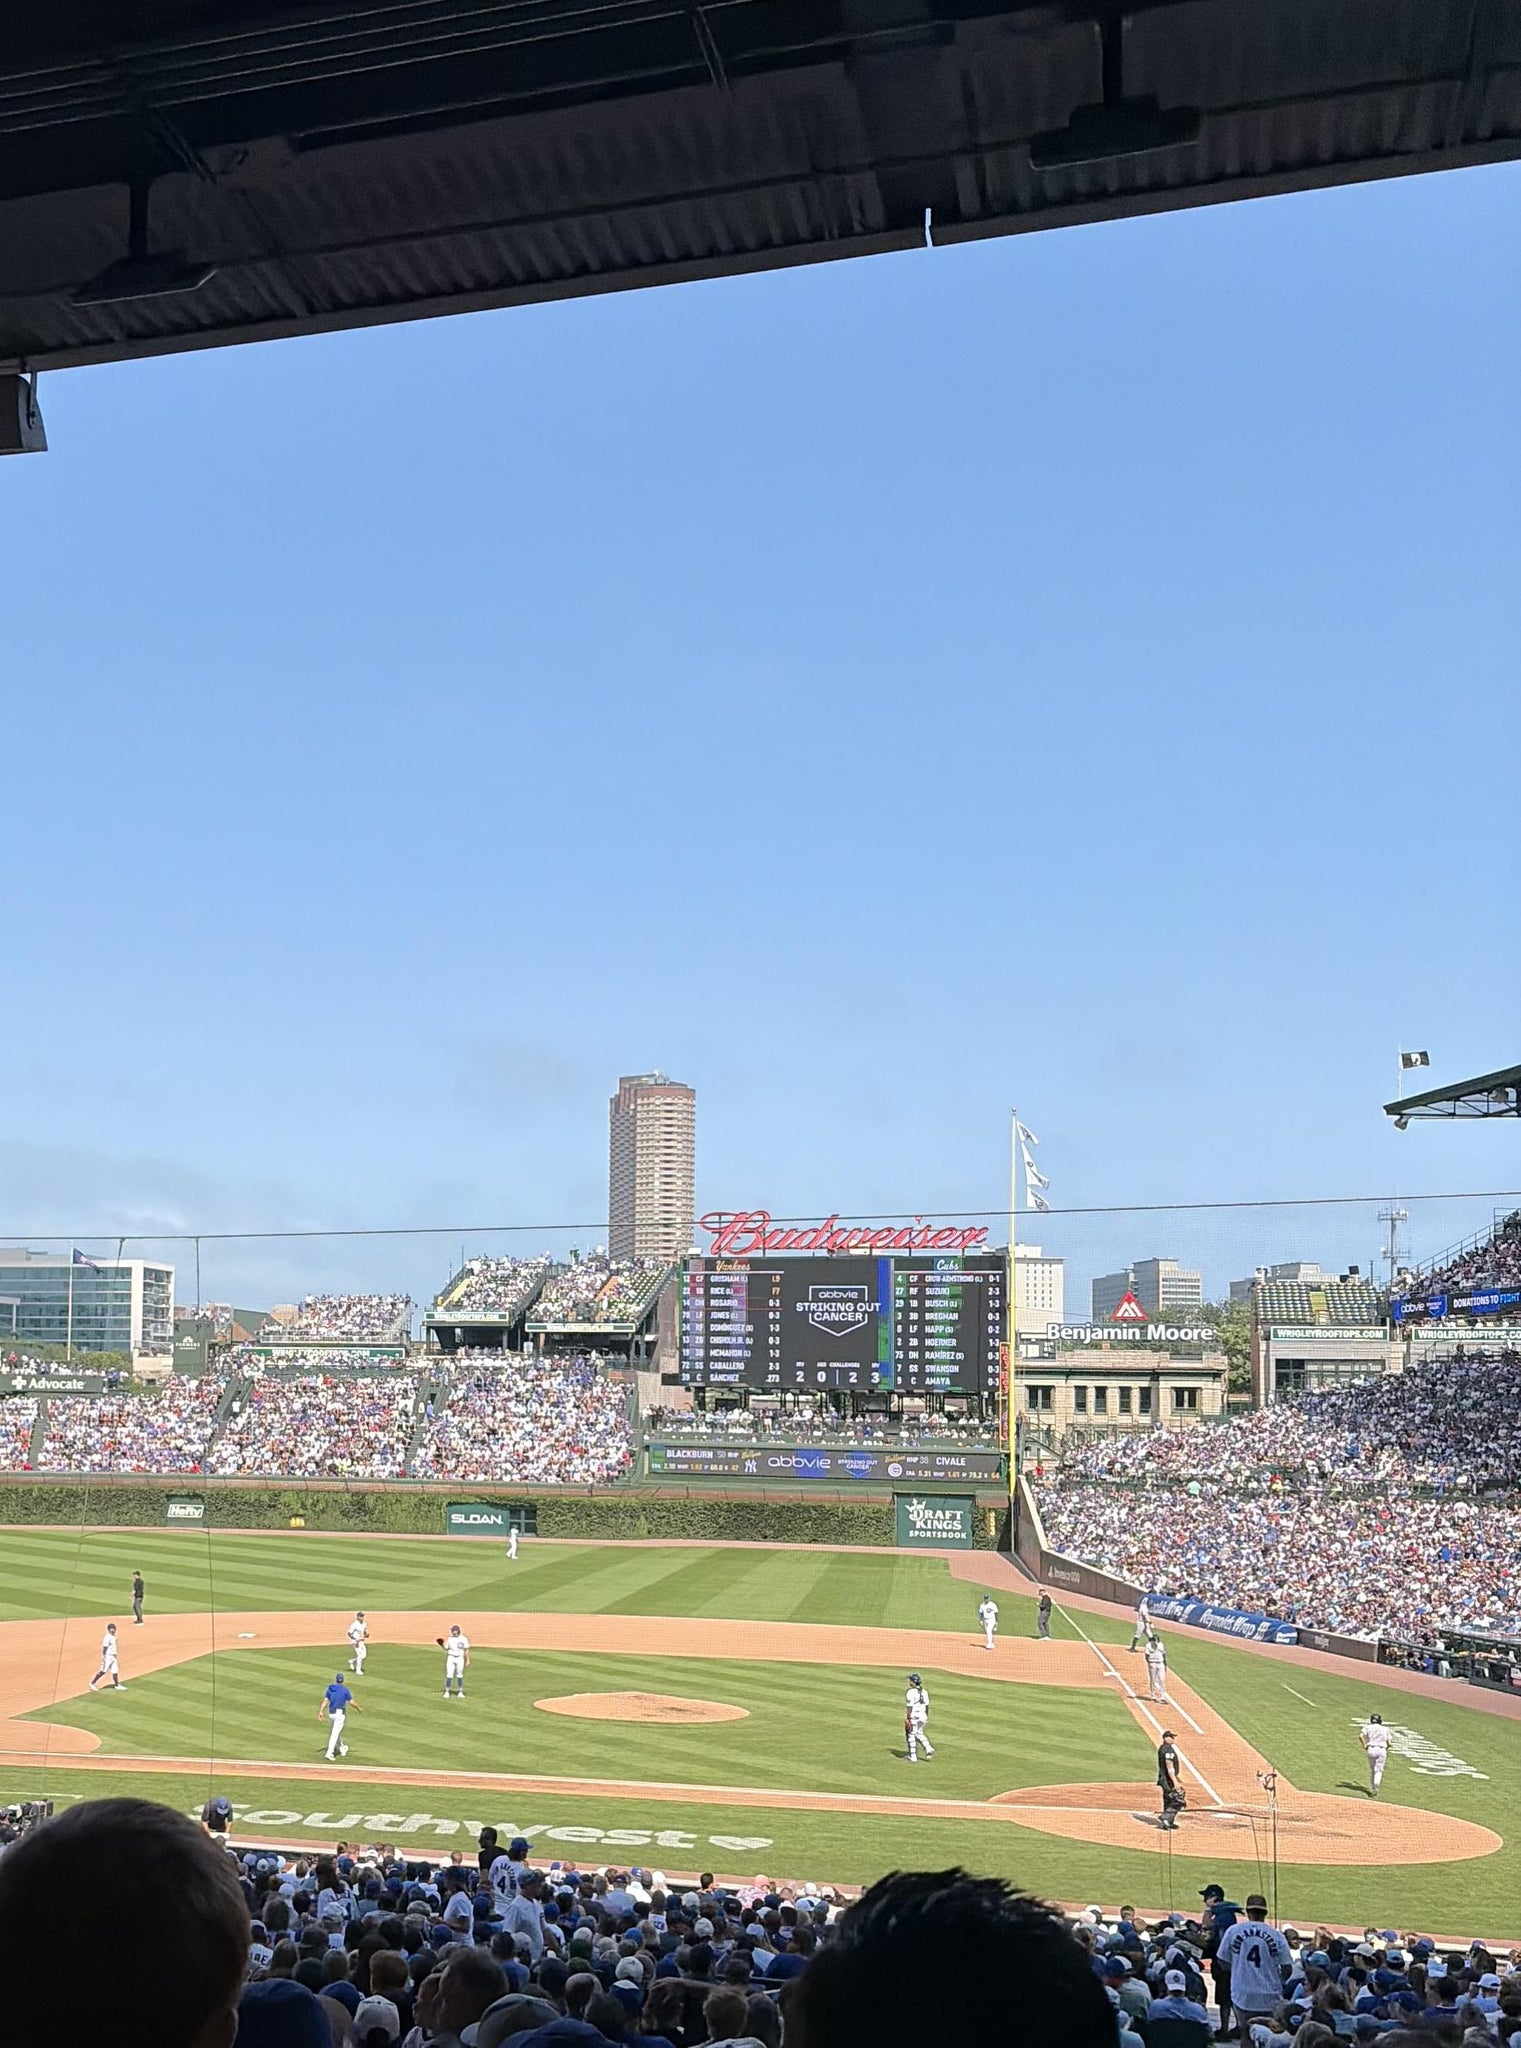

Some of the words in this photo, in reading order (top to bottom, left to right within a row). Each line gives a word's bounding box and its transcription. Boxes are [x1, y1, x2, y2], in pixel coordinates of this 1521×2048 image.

[700, 1210, 989, 1255] Budweiser
[716, 1260, 751, 1272] Yankees
[937, 1259, 959, 1271] Cubs
[897, 1275, 902, 1283] 4
[909, 1275, 918, 1283] CF
[988, 1275, 1000, 1283] 0-1
[710, 1287, 725, 1295] RICE
[818, 1290, 858, 1299] abbvie
[895, 1287, 904, 1295] 27
[925, 1287, 950, 1295] SUZUKI
[987, 1287, 1000, 1295] 2-3
[710, 1299, 738, 1307] ROSARIO
[769, 1299, 780, 1307] 0-3
[925, 1299, 949, 1307] BUSCH
[988, 1299, 1000, 1307] 1-3
[1453, 1296, 1490, 1309] DONATIONS
[1491, 1294, 1499, 1305] TO
[1500, 1292, 1520, 1304] FIGHT
[796, 1302, 854, 1312] STRIKING
[856, 1303, 881, 1312] OUT
[1401, 1302, 1425, 1313] abbvie
[710, 1311, 730, 1319] JONES
[769, 1311, 780, 1319] 0-3
[813, 1312, 863, 1321] CANCER
[897, 1312, 902, 1320] 3
[987, 1312, 1000, 1320] 0-3
[769, 1323, 780, 1332] 1-3
[909, 1325, 918, 1333] LF
[925, 1325, 945, 1333] HAPP
[987, 1325, 1000, 1333] 0-2
[1047, 1323, 1141, 1344] Benjamin
[1147, 1324, 1214, 1341] Moore
[768, 1336, 780, 1344] 0-3
[897, 1338, 902, 1347] 2
[988, 1338, 1000, 1347] 1-3
[769, 1349, 780, 1357] 1-3
[895, 1351, 904, 1359] 75
[909, 1351, 919, 1359] DH
[987, 1351, 1000, 1359] 0-3
[897, 1364, 902, 1373] 7
[909, 1364, 919, 1373] SS
[987, 1364, 1000, 1373] 0-3
[795, 1371, 805, 1382] 2
[817, 1371, 826, 1382] 0
[849, 1372, 858, 1383] 2
[871, 1372, 880, 1383] 3
[911, 1376, 917, 1386] C
[925, 1376, 951, 1386] AMAYA
[987, 1376, 1000, 1386] 0-3
[28, 1377, 85, 1390] Advocate
[666, 1450, 713, 1459] BLACKBURN
[768, 1455, 831, 1469] abbvie
[936, 1457, 966, 1466] CIVALE
[451, 1513, 503, 1525] SLOAN
[909, 1509, 964, 1521] DRAFT
[915, 1518, 963, 1531] KINGS
[908, 1530, 968, 1540] SPORTSBOOK
[1199, 1608, 1233, 1631] Reynolds
[1231, 1616, 1257, 1639] Wrap
[496, 1875, 506, 1894] 4
[1246, 1944, 1261, 1969] 4
